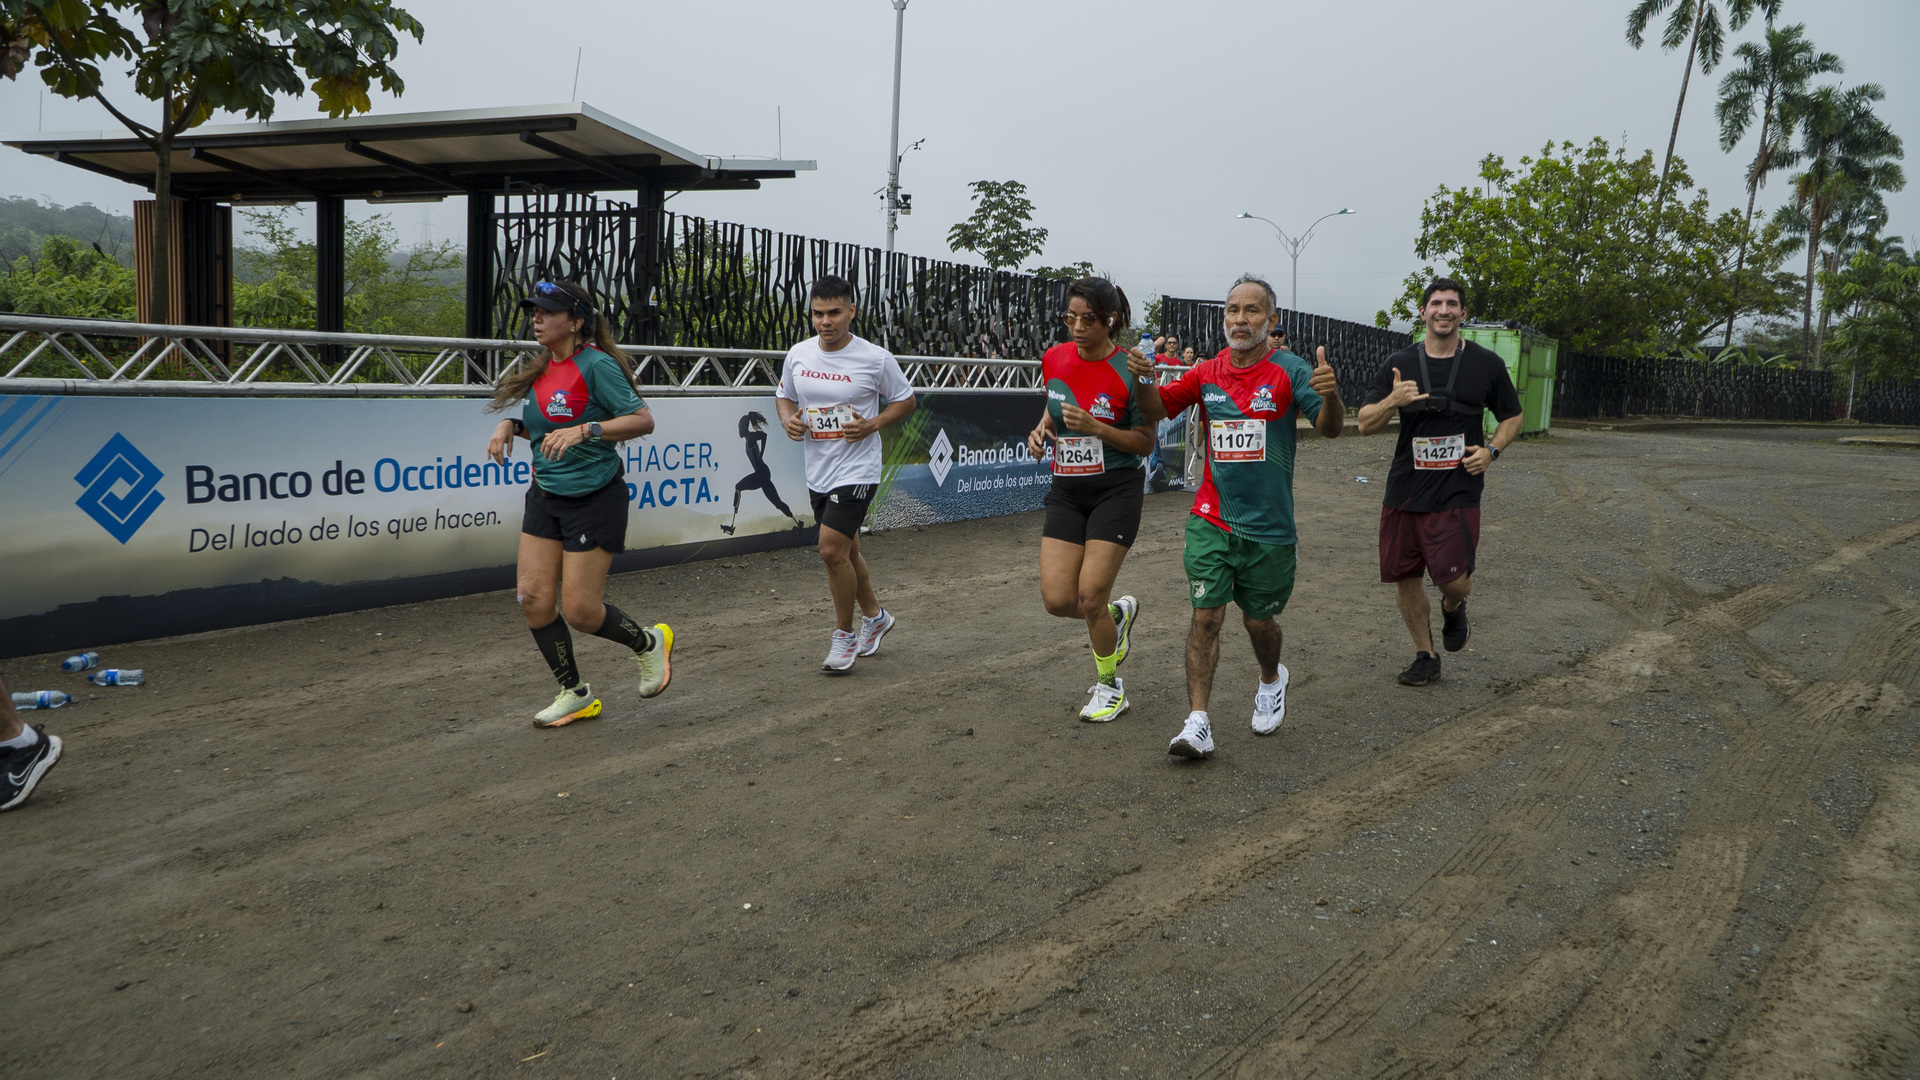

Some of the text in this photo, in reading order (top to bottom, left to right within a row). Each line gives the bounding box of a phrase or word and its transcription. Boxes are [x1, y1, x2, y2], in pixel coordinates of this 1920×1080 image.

[800, 369, 852, 383] HONDA
[817, 417, 839, 430] 341
[1216, 433, 1255, 448] 1107
[626, 442, 719, 473] HACER,
[958, 444, 997, 467] Banco
[999, 442, 1014, 463] de
[1060, 449, 1093, 463] 1264
[1422, 446, 1456, 459] 1427
[185, 455, 530, 505] Banco de Occidente
[957, 477, 973, 493] Del
[973, 476, 992, 491] lado
[993, 474, 1004, 489] de
[1005, 473, 1018, 488] los
[1018, 476, 1033, 489] que
[189, 508, 502, 553] Del lado de los que hacen.
